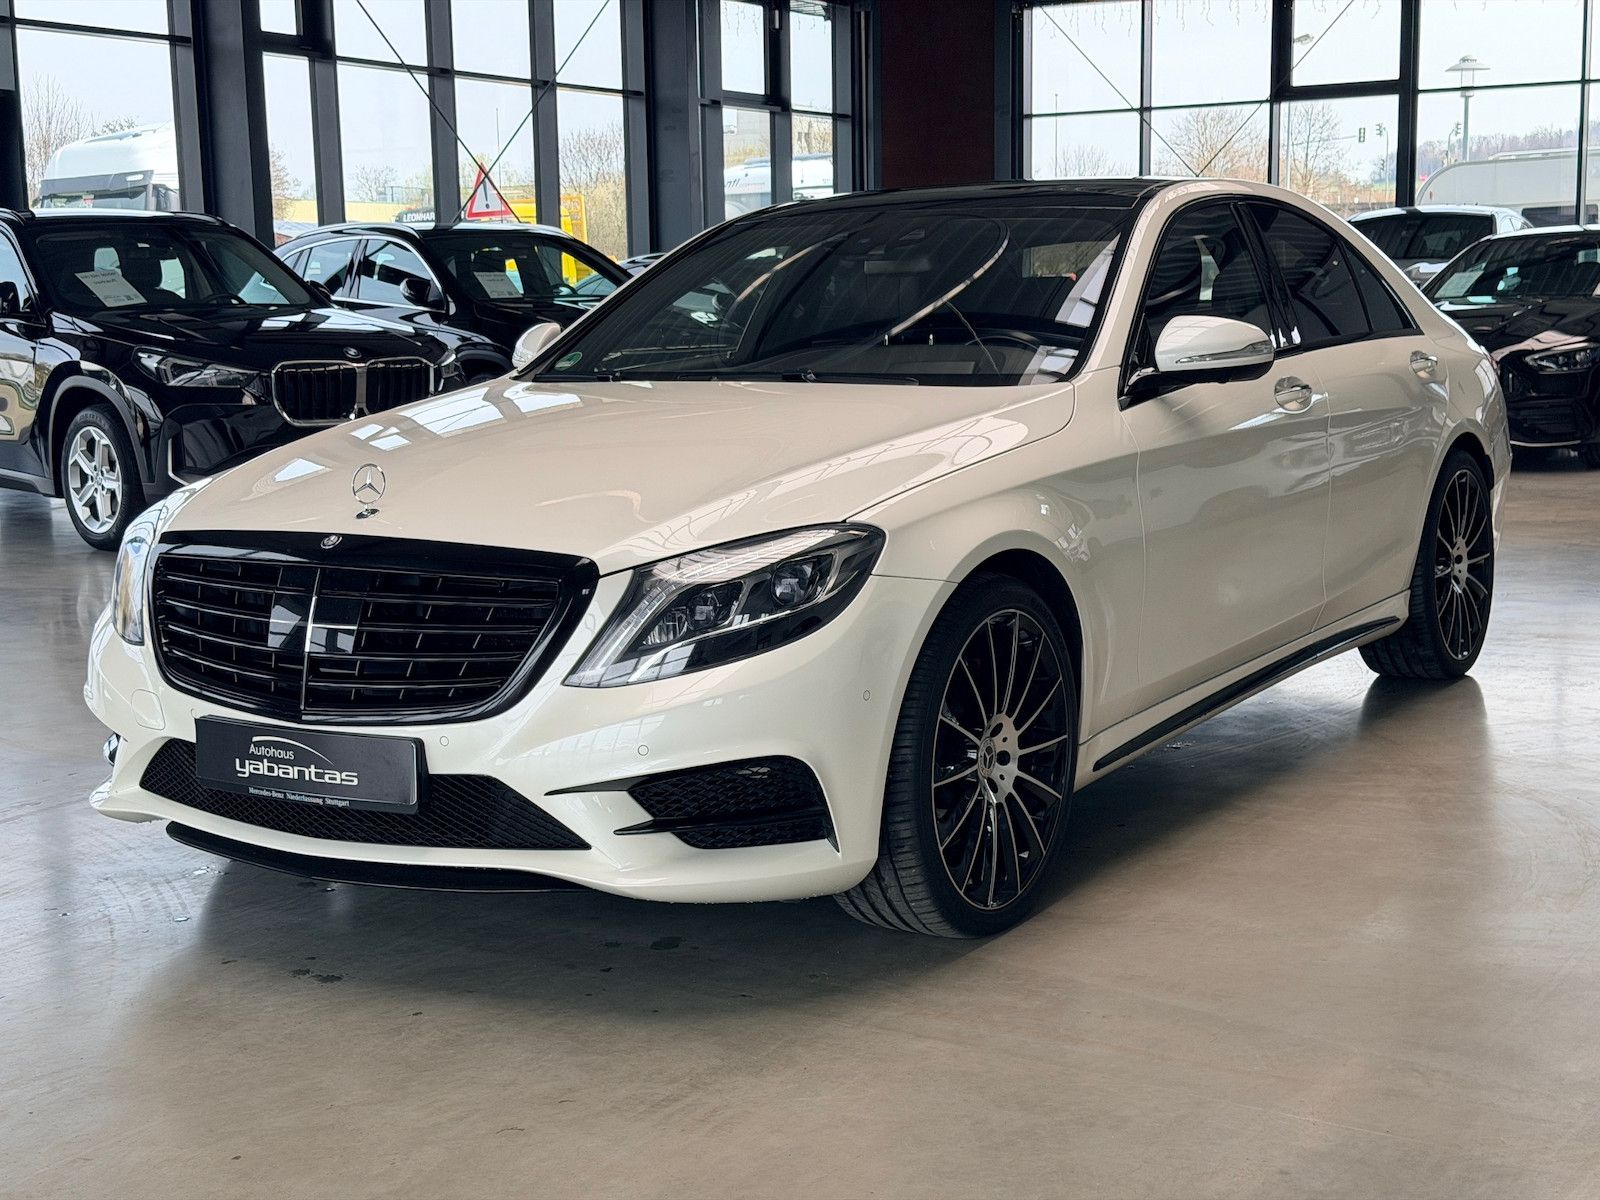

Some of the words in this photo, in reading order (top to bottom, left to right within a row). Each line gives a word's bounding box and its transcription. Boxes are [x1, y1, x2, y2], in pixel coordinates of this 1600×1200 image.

[403, 212, 435, 222] LEONHAR
[249, 743, 294, 760] Autohaus
[235, 758, 358, 786] yabantas
[249, 787, 284, 799] Mercedes-Benz
[286, 793, 324, 805] Niederlassung
[325, 797, 350, 808] Stuttgart
